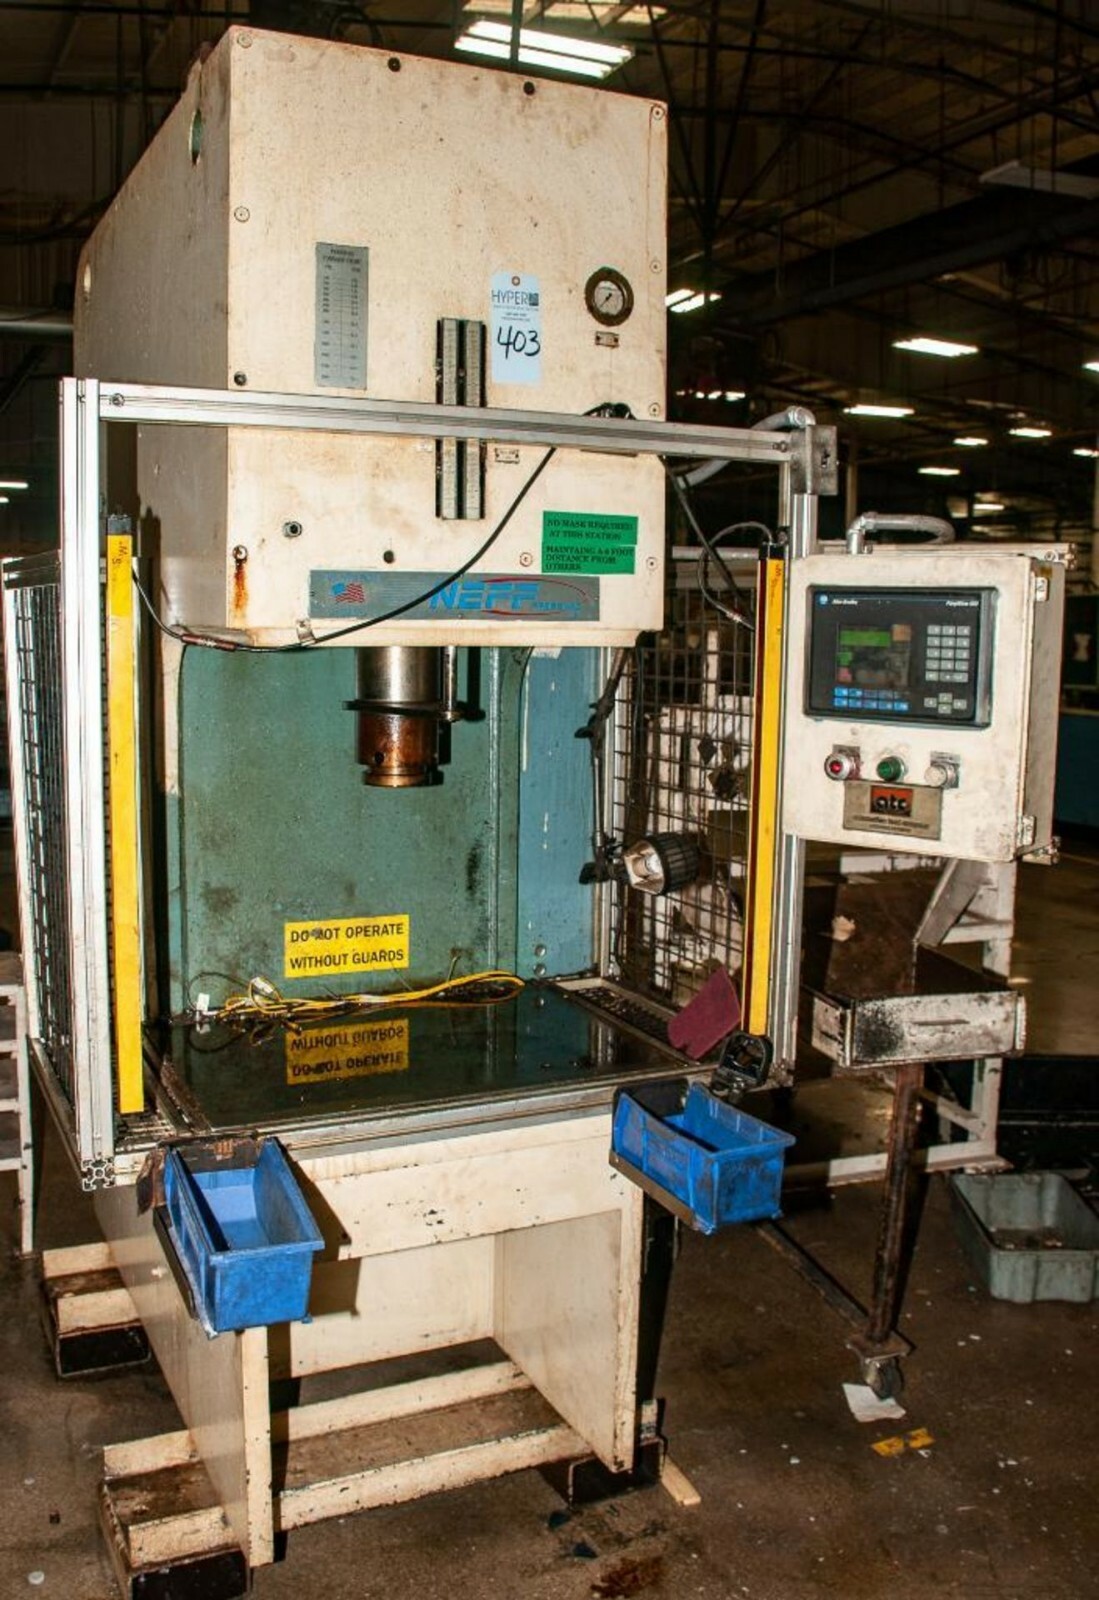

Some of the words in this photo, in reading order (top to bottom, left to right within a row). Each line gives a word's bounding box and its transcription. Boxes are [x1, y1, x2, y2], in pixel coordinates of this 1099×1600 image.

[497, 326, 541, 360] 403
[562, 520, 586, 529] MASK
[549, 530, 560, 538] AT
[563, 530, 582, 539] THIS
[584, 531, 622, 541] STATION
[546, 554, 588, 563] DISTANCE
[545, 563, 581, 571] OTHERS
[428, 581, 539, 610] NEFF
[290, 930, 310, 943] DO
[345, 922, 405, 940] OPERATE
[290, 953, 349, 970] WITHOUT
[352, 949, 405, 965] GUARDS
